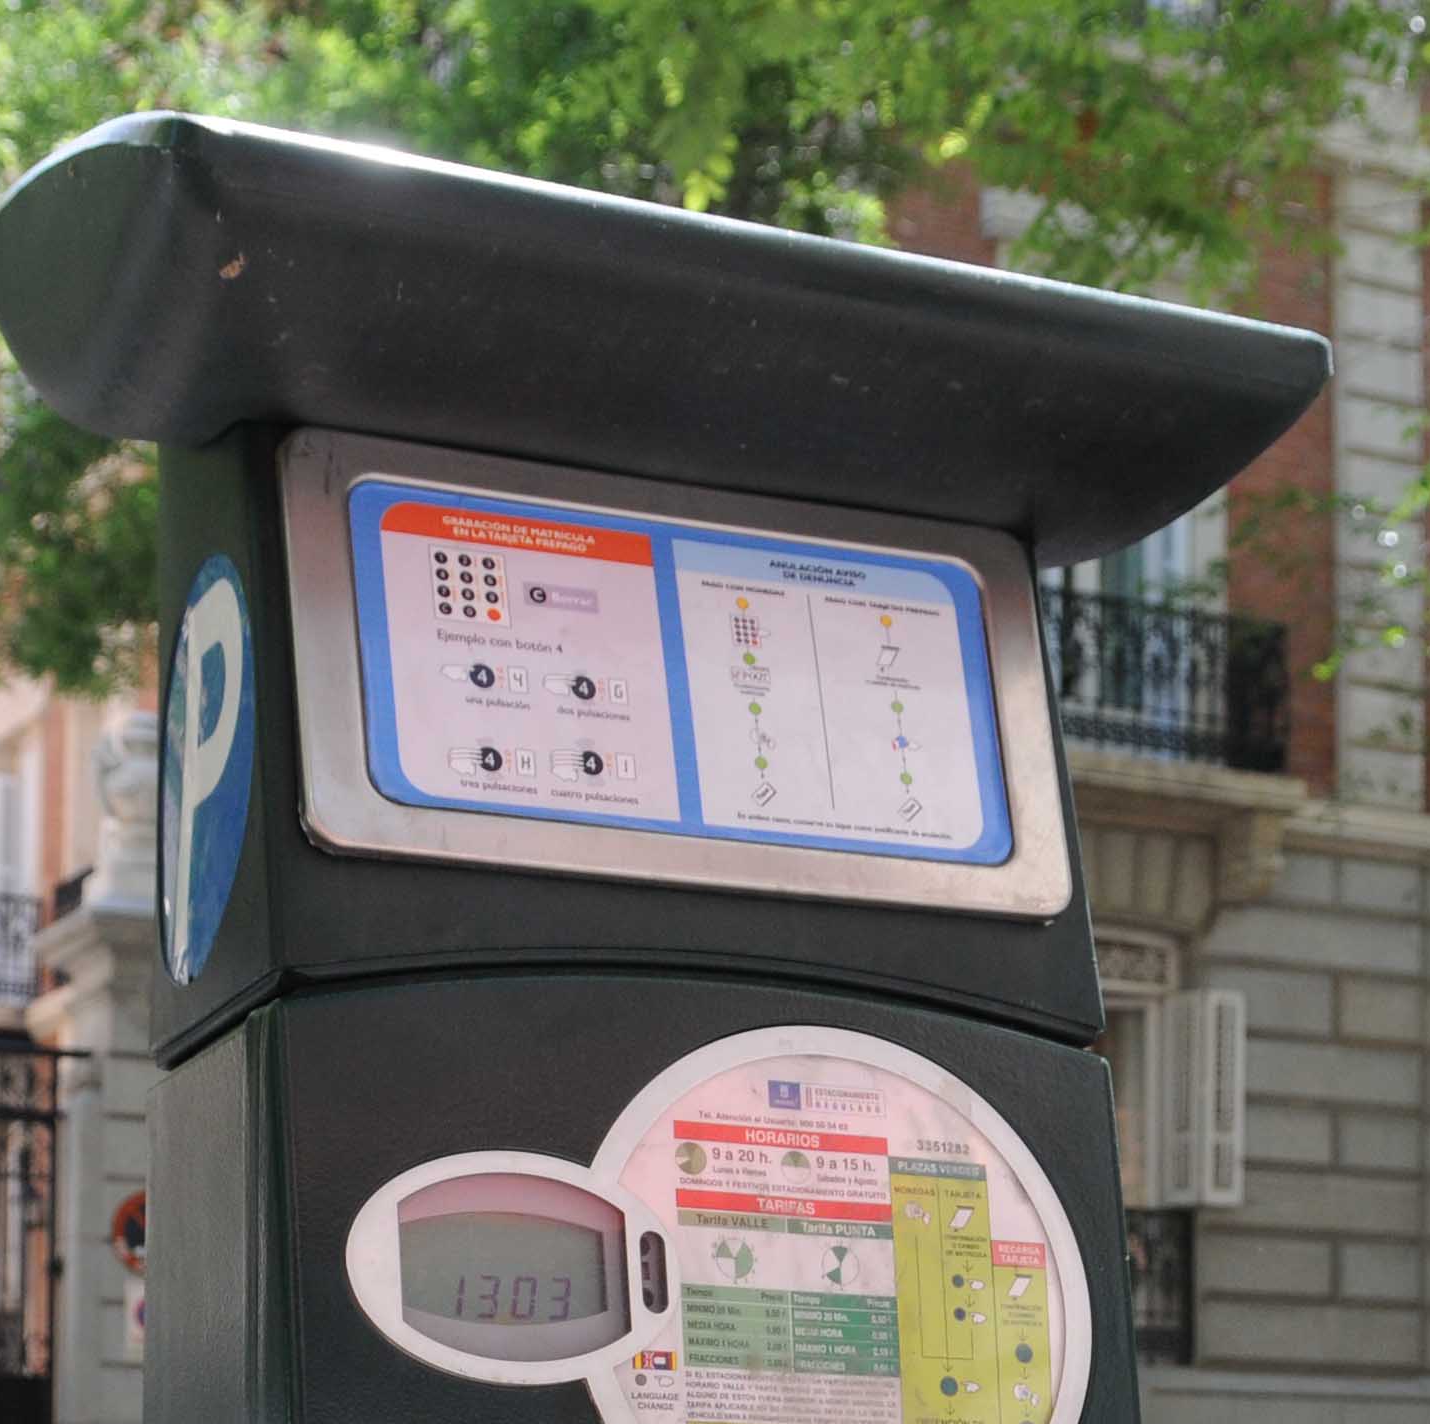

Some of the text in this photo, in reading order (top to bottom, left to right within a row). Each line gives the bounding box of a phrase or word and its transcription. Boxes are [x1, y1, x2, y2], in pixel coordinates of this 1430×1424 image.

[513, 523, 528, 535] DE
[453, 526, 587, 552] EN LA TARJETA PREPAGO
[770, 559, 867, 580] ANULACIÓN AVISO
[782, 571, 856, 587] DE DENUNCIA
[437, 629, 485, 646] Ejemplo
[489, 638, 512, 648] con
[516, 638, 552, 653] botón
[465, 697, 530, 711] una pulsación
[557, 706, 630, 721] dos pulsaciones
[174, 577, 243, 972] P
[482, 780, 538, 795] pulsaciones
[551, 788, 639, 805] cuatro pulsaciones
[814, 1087, 879, 1101] ESTACIONAMIENTO
[745, 1129, 820, 1148] HORARIOS
[712, 1148, 772, 1164] 9 a 20 h.
[713, 1165, 734, 1175] Lunes
[816, 1157, 876, 1172] 9 a 15 h.
[897, 1160, 938, 1173] PLAZAS
[679, 1177, 723, 1188] DOMINGOS
[732, 1180, 770, 1192] FESTIVOS
[771, 1183, 845, 1198] ESTACIONAMIENTO
[846, 1190, 886, 1200] GRATUITO
[756, 1197, 815, 1216] TARIFAS
[696, 1213, 768, 1229] Tarifa VALLE
[801, 1221, 876, 1237] Tarifa PUNTA
[1001, 1254, 1040, 1265] TARJETA
[455, 1275, 572, 1321] 1303
[631, 1392, 679, 1401] LANGUAGE
[637, 1402, 674, 1411] CHANGE
